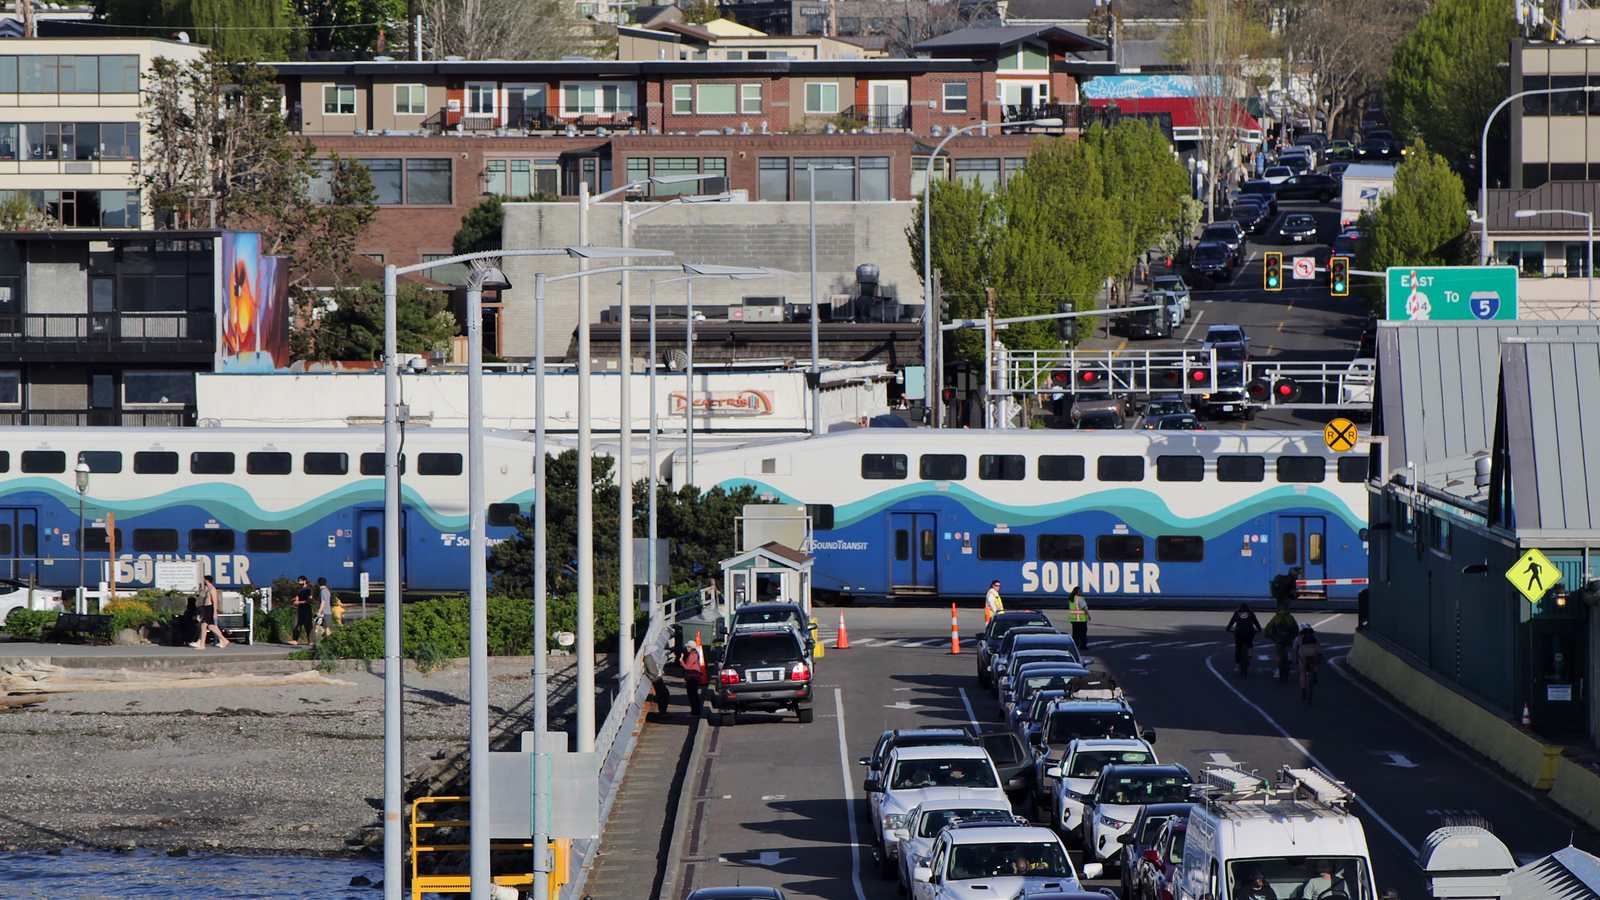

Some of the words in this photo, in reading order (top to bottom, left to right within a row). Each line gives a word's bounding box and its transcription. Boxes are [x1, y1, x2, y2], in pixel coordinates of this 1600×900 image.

[1479, 300, 1491, 316] 5
[119, 553, 251, 585] SODER
[1021, 561, 1161, 593] SOUNDER
